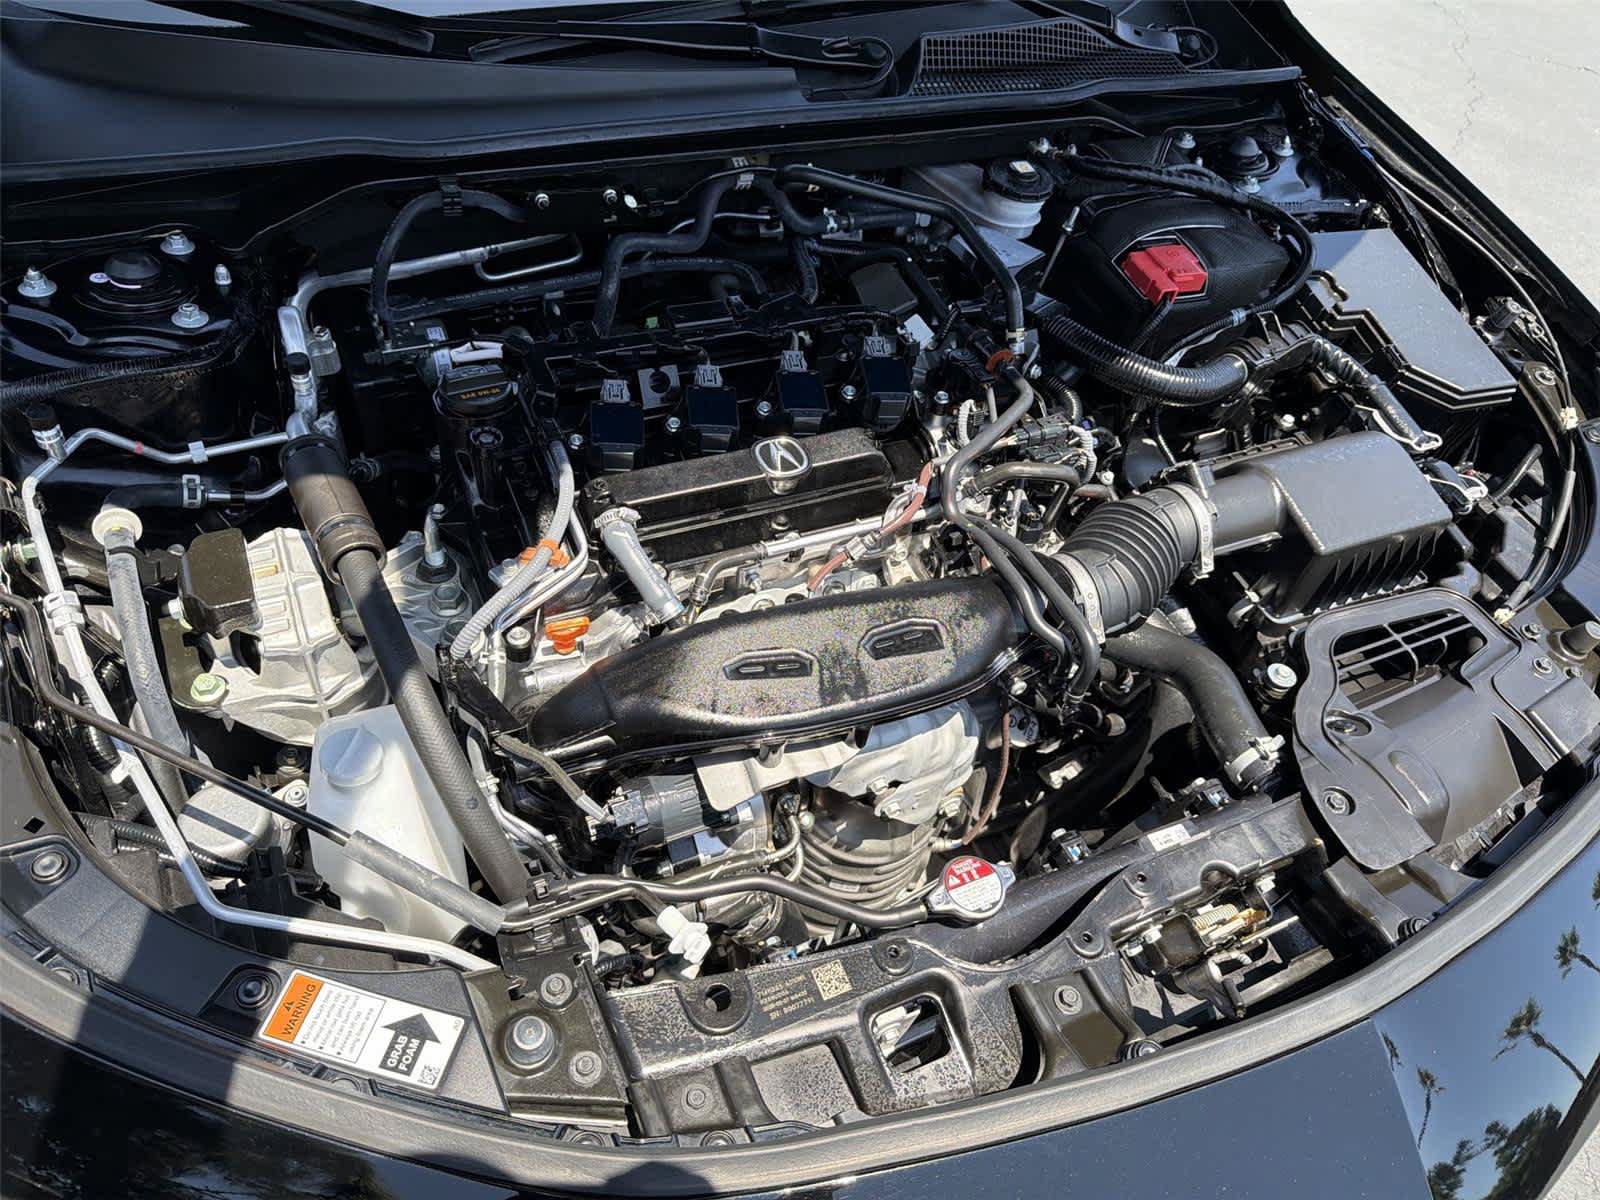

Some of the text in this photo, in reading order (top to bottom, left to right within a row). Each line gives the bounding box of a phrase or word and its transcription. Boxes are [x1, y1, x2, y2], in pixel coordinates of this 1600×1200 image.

[281, 983, 316, 1036] WARNING
[386, 1034, 408, 1067] GRAB
[398, 1037, 420, 1071] FOAM
